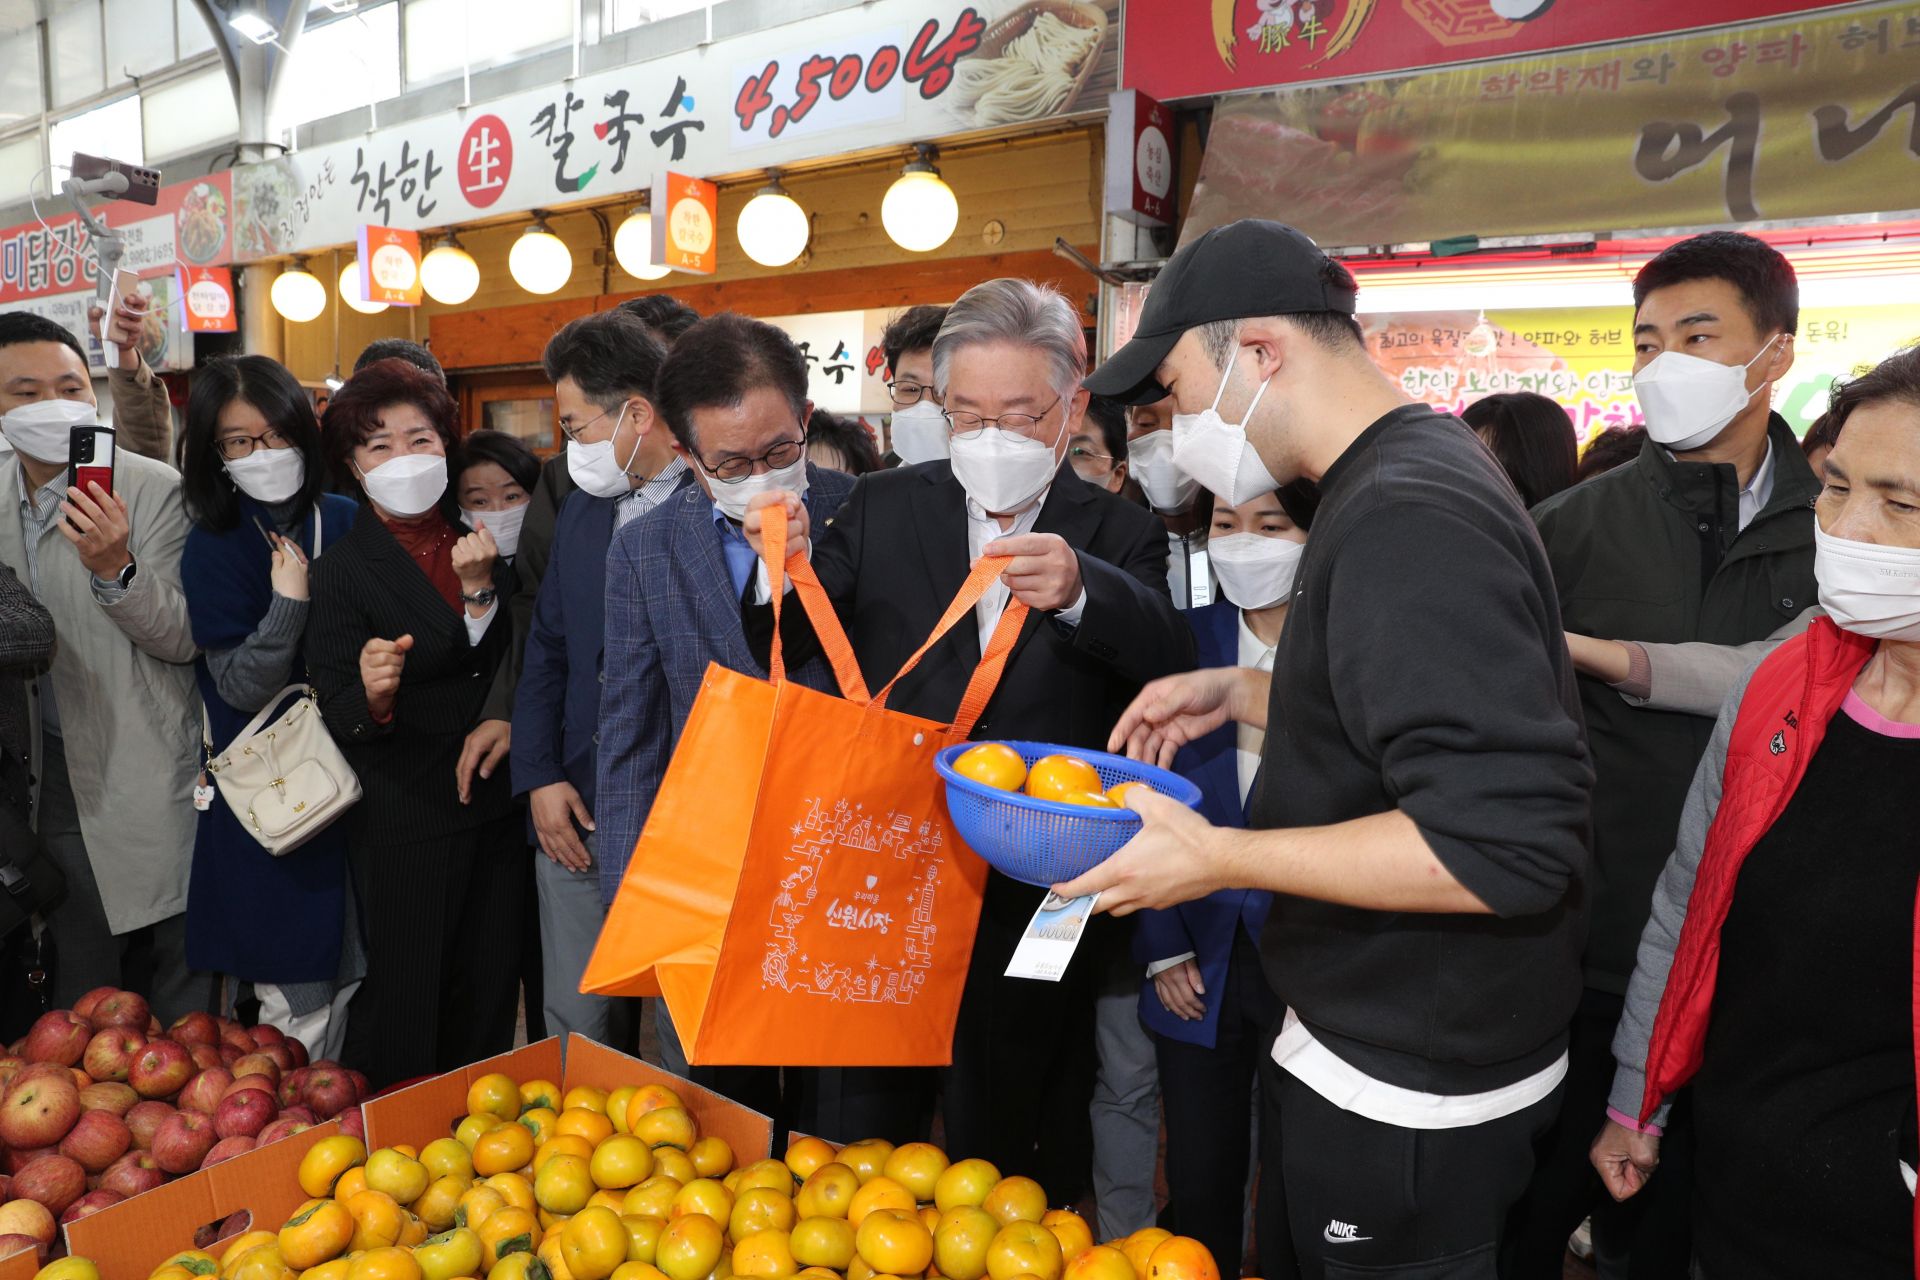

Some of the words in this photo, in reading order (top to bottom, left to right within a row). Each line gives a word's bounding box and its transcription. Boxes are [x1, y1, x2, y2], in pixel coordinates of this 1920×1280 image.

[1702, 33, 1808, 78] 양파
[350, 141, 443, 227] 착한
[465, 127, 503, 195] 生
[530, 75, 705, 193] 칼국수
[1144, 196, 1161, 215] A-6
[681, 253, 702, 268] A-5
[385, 290, 405, 301] A-4
[203, 319, 222, 329] A-3
[1379, 332, 1424, 349] 최고의
[1523, 331, 1581, 346] 양파와
[1589, 329, 1622, 345] 허브
[1806, 320, 1848, 342] 돈육!
[826, 898, 894, 934] 신원시장
[1329, 1219, 1358, 1238] NIKE
